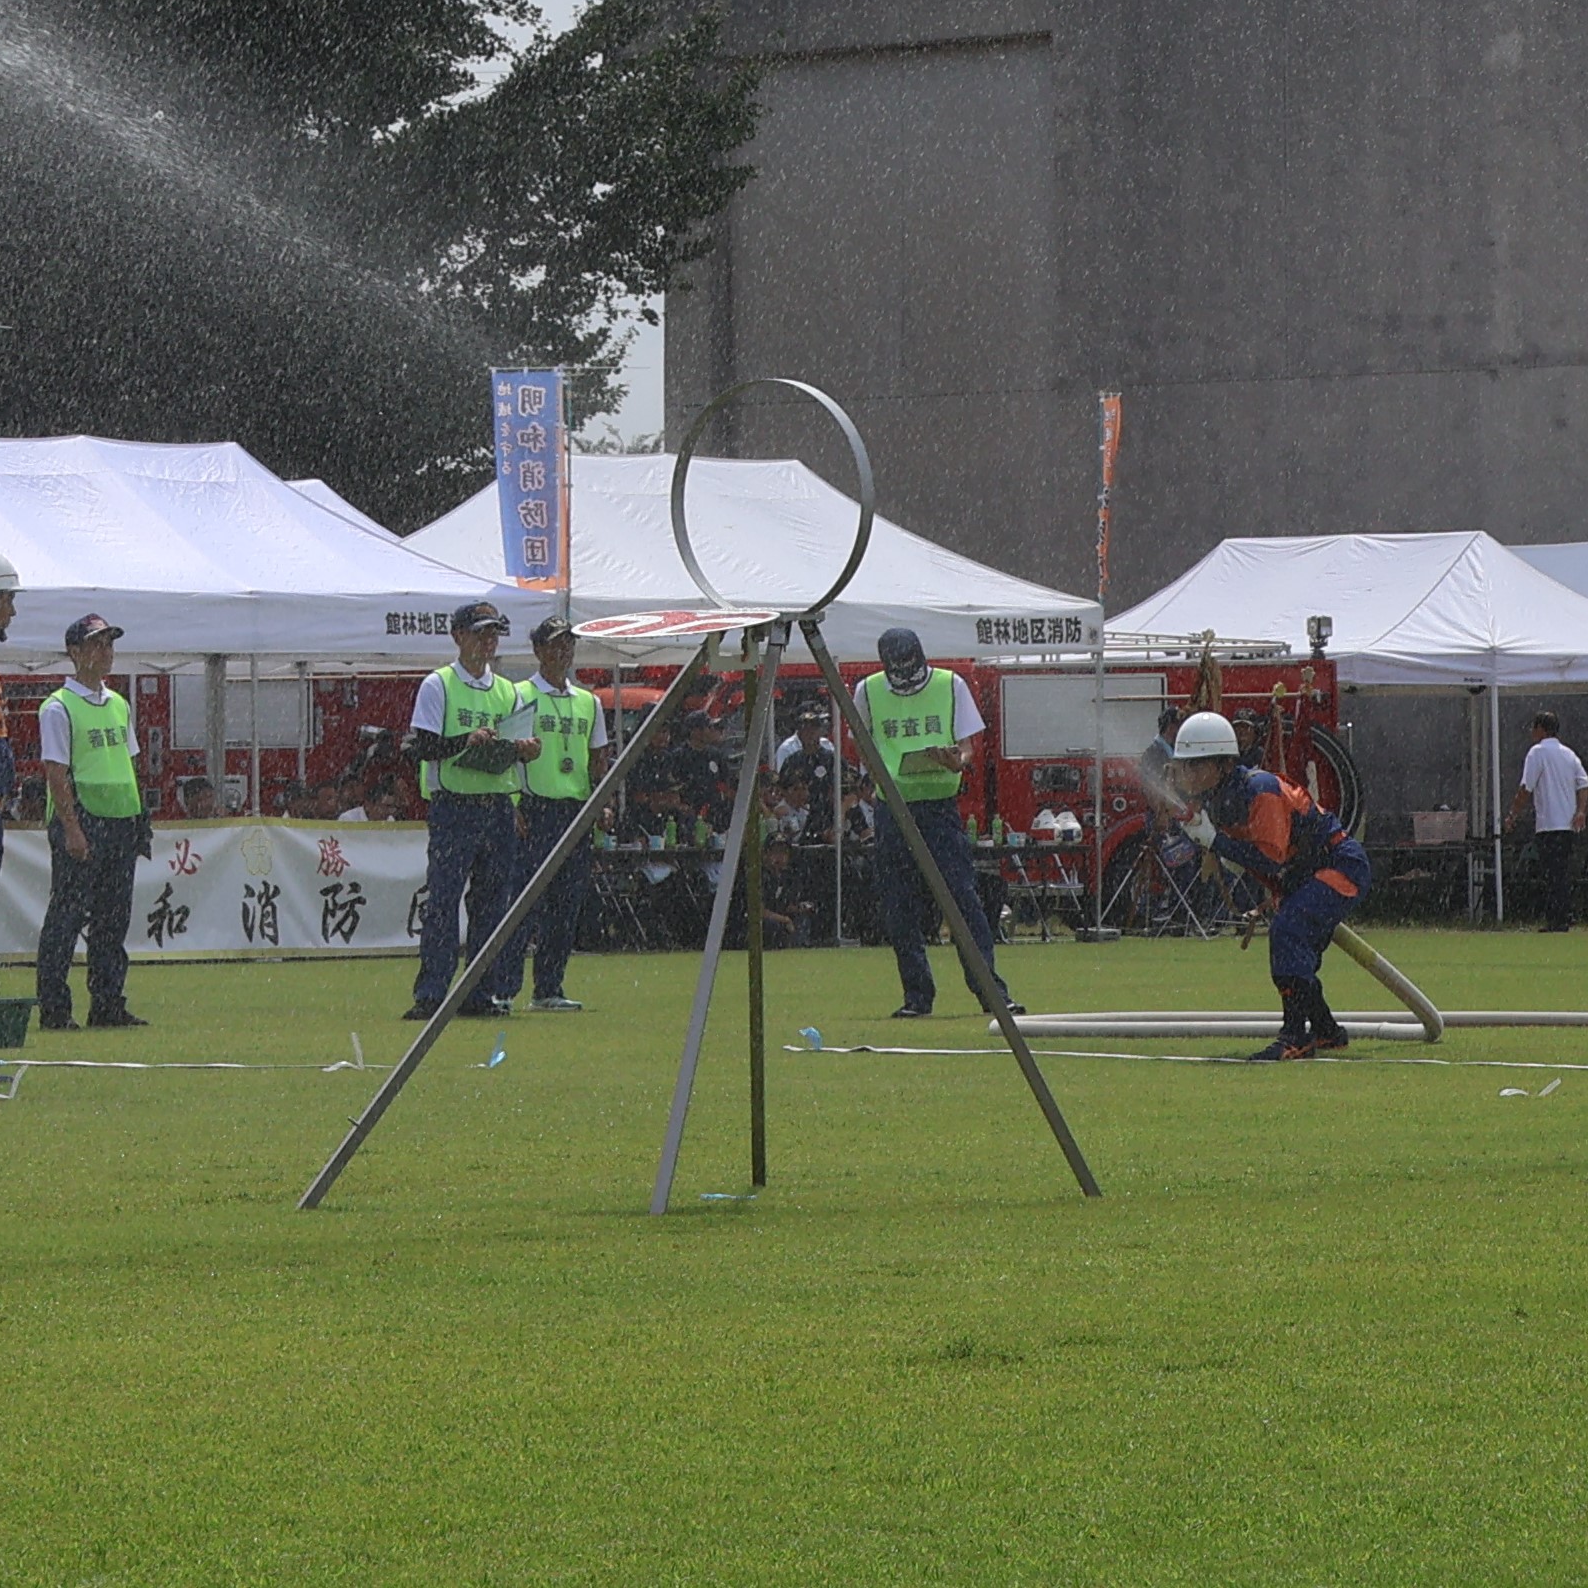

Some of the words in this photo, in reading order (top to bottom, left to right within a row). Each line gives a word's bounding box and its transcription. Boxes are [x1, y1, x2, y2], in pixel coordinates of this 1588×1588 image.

[386, 611, 511, 637] 館林地区会
[976, 616, 1082, 645] 館林地区消防
[881, 715, 943, 739] 審査員
[80, 880, 430, 947] 和消防
